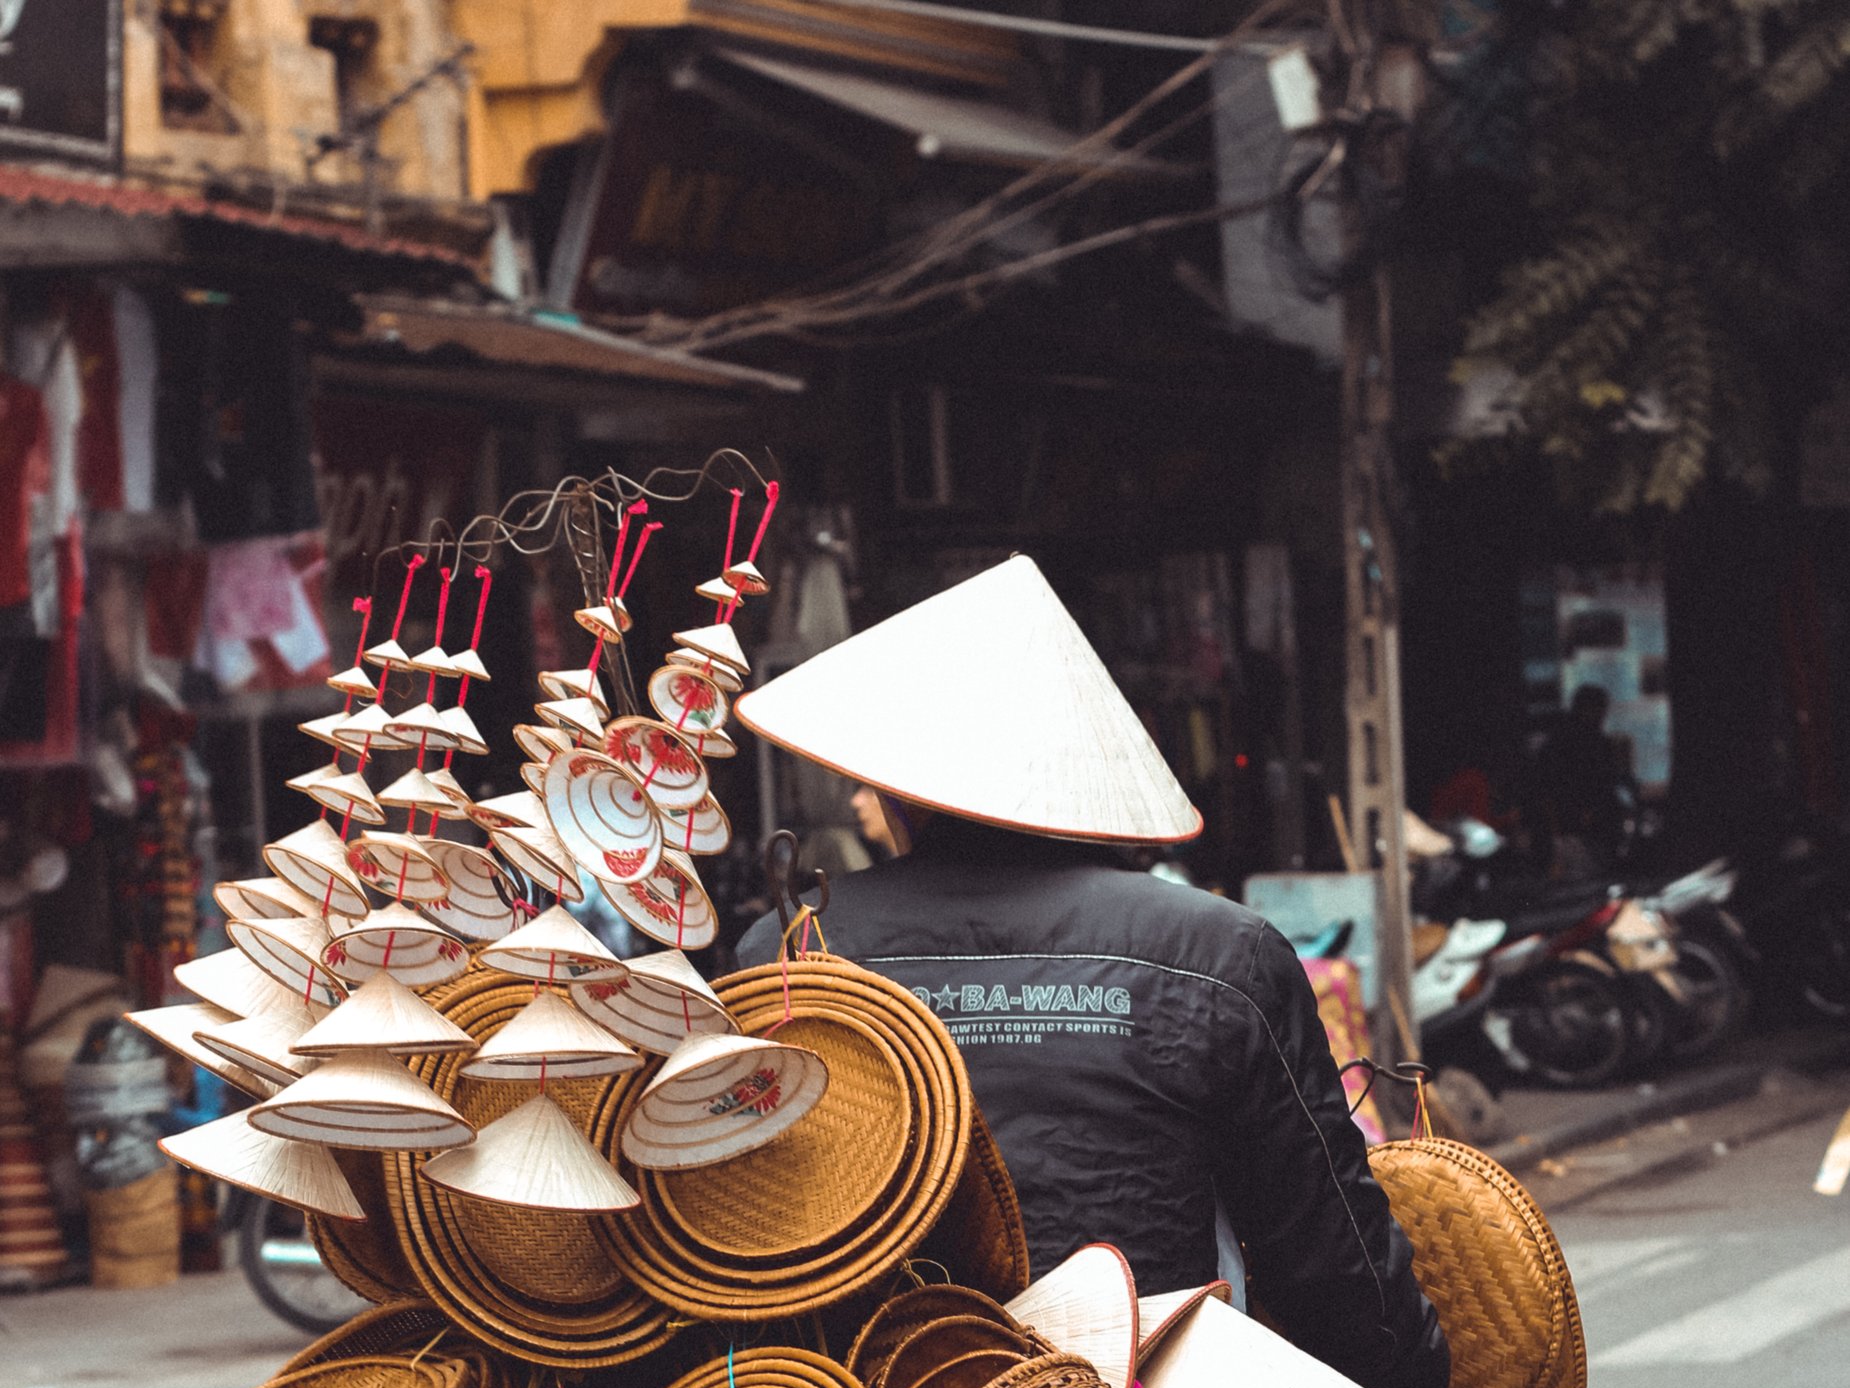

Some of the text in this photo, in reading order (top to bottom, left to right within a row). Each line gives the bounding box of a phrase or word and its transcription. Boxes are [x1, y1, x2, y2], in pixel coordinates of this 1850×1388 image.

[947, 1022, 1132, 1037] AWTEST CONTACT SPORTS IS
[953, 1034, 988, 1045] HION
